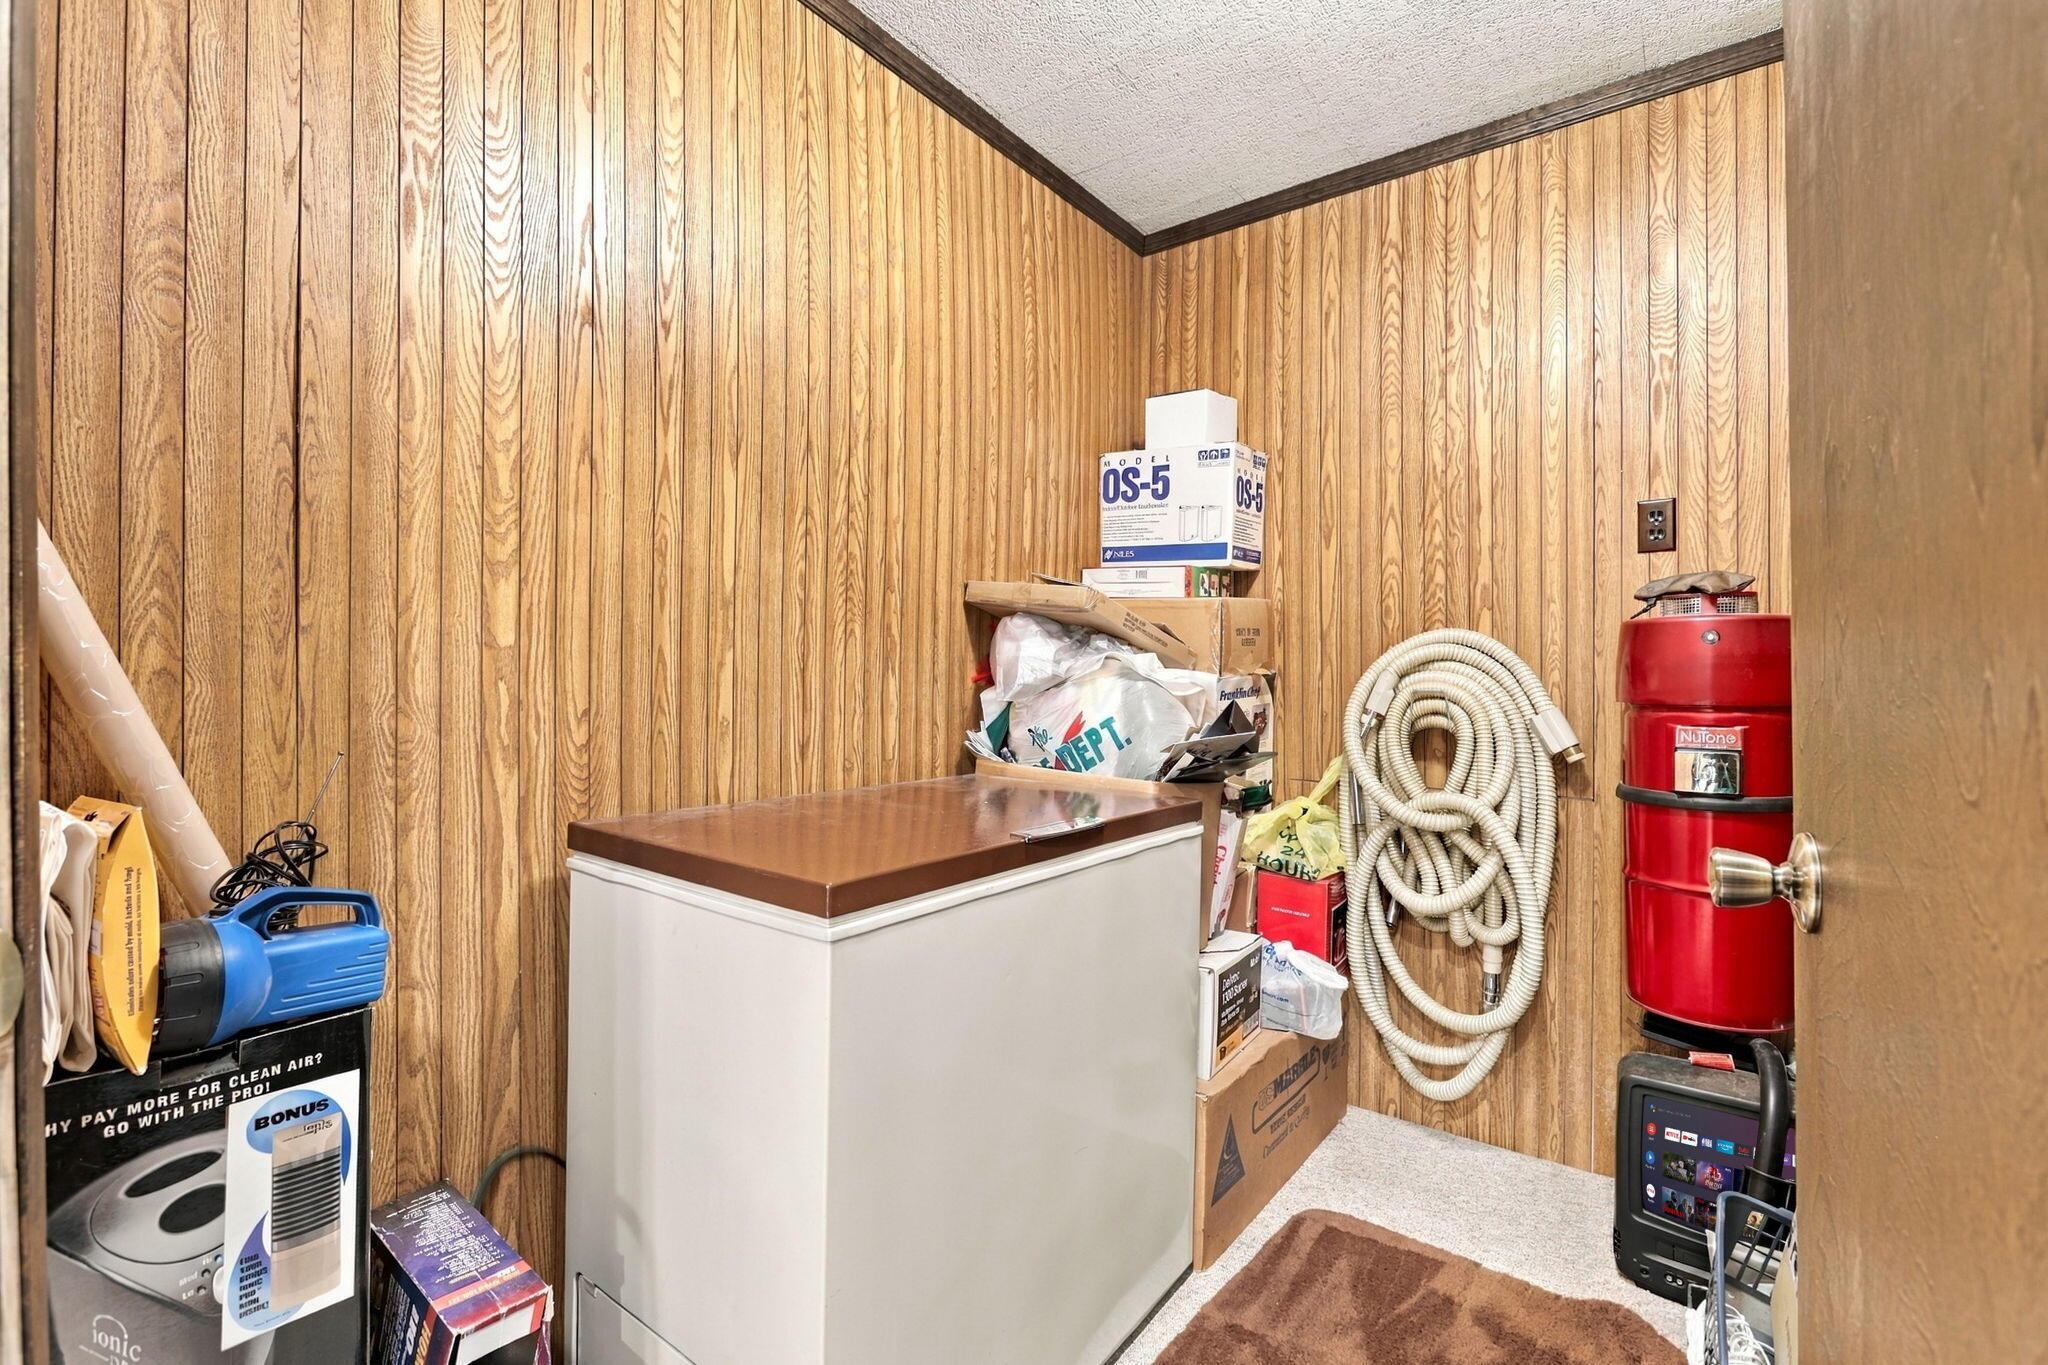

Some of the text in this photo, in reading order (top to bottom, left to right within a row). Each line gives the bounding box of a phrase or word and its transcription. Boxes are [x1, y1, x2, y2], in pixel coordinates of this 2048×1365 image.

[1103, 455, 1170, 467] MODEL
[1103, 464, 1170, 504] OS-5
[1236, 475, 1263, 513] OS-5
[1112, 550, 1135, 559] NILES
[1220, 688, 1246, 701] Franklin
[1055, 716, 1133, 773] DEPT.
[1680, 730, 1736, 744] NuTone
[1280, 845, 1305, 859] 24
[124, 883, 132, 895] and
[125, 938, 134, 947] by
[45, 1052, 324, 1138] HY PAY MORE FOR CLEAN AIR?
[103, 1081, 271, 1139] GO WITH THE PRO!
[254, 1098, 330, 1131] BONUS
[92, 1320, 142, 1362] ionic
